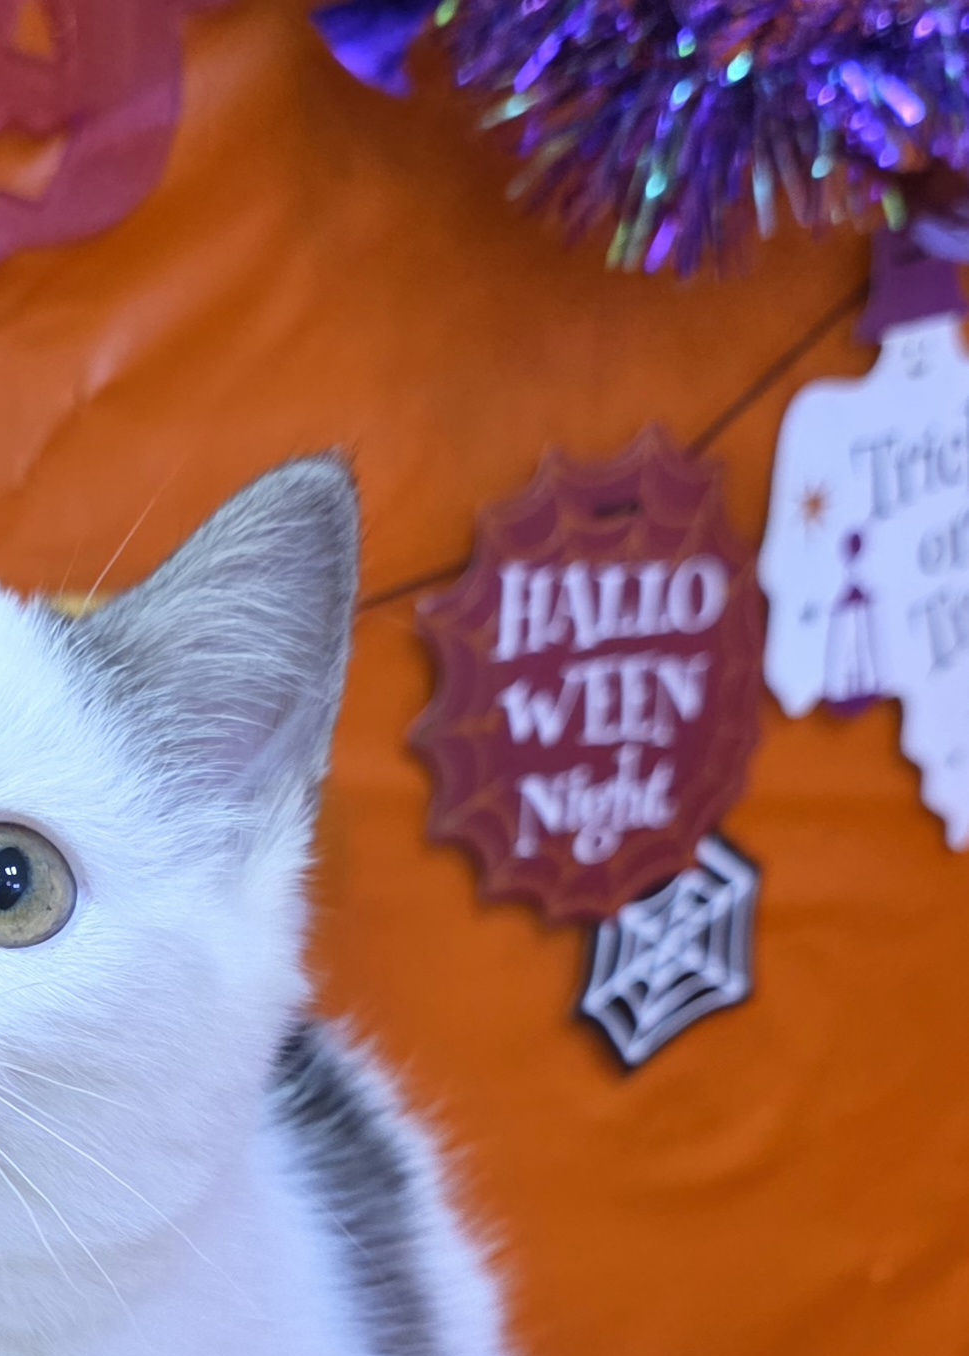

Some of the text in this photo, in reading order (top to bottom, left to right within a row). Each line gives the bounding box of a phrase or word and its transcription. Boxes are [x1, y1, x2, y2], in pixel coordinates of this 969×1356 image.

[849, 402, 969, 520] Tric
[492, 552, 729, 662] HALLO
[514, 742, 676, 864] Night
